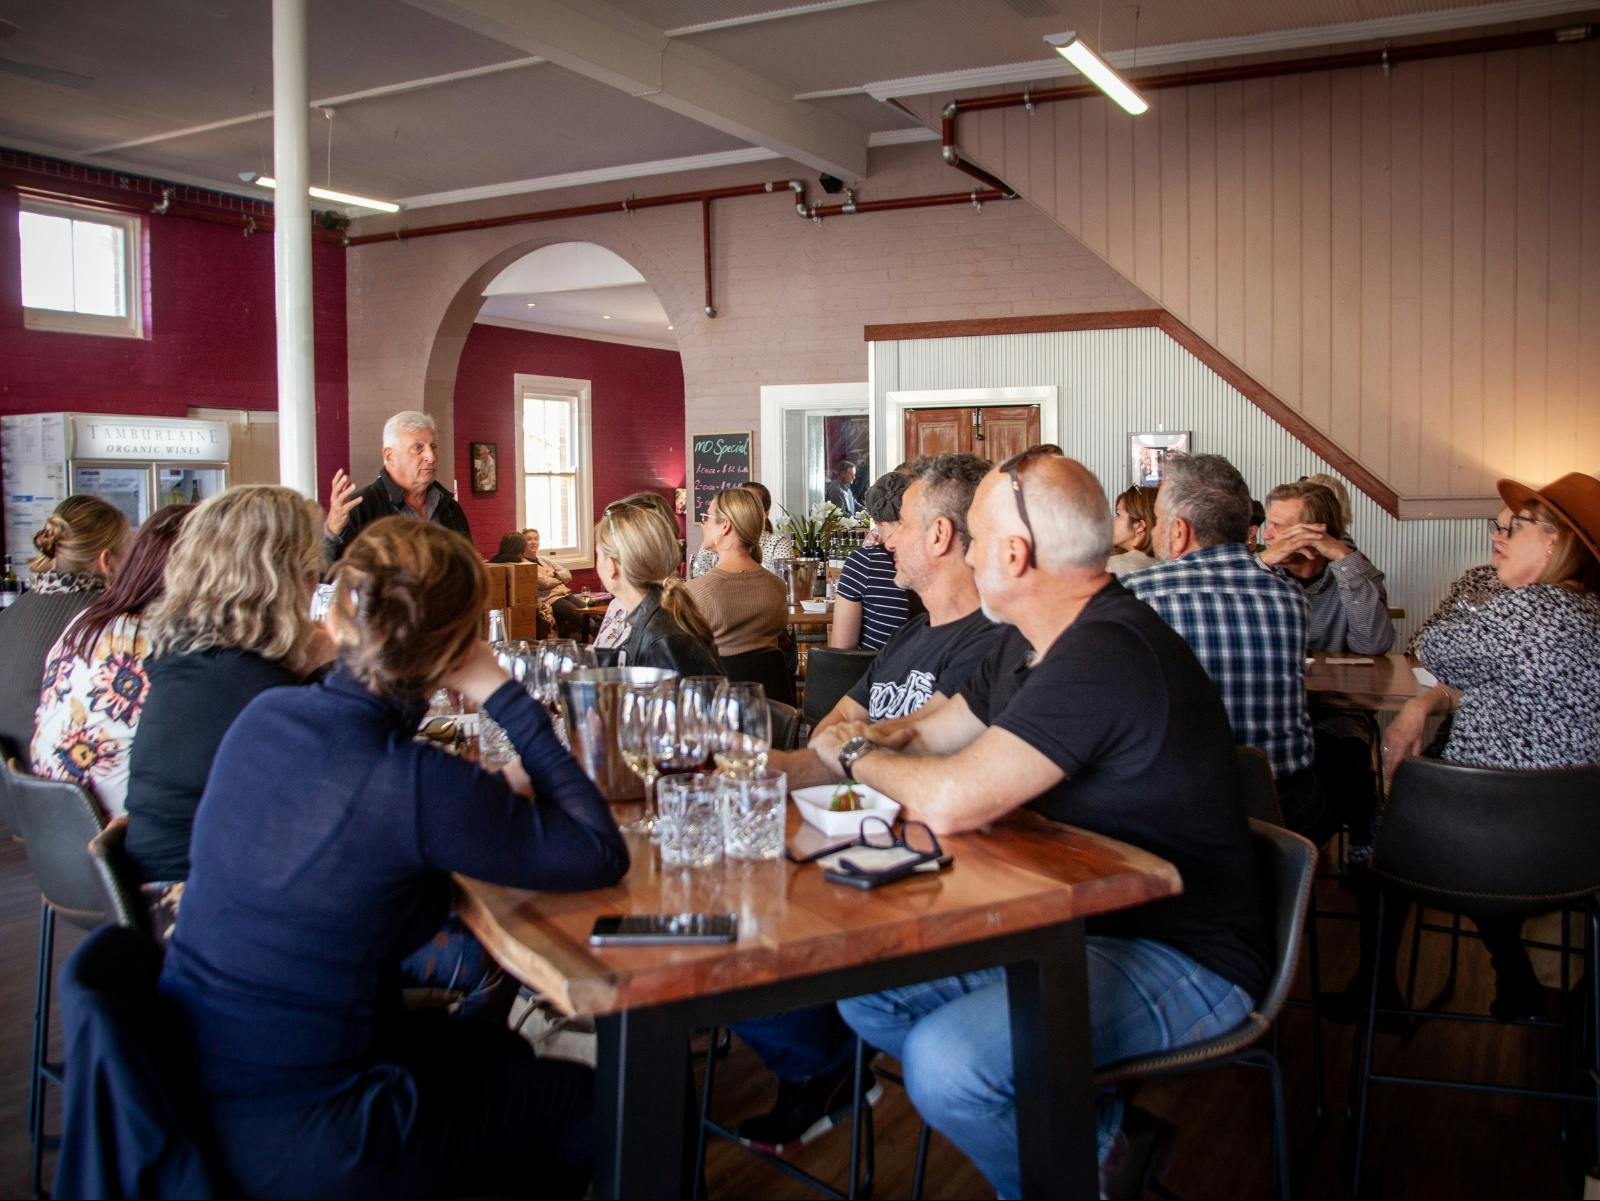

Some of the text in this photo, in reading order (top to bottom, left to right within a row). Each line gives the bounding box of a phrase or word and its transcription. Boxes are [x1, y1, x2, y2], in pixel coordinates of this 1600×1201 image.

[87, 424, 219, 444] TAMBURLAINE
[106, 444, 201, 455] ORGANIC WINES
